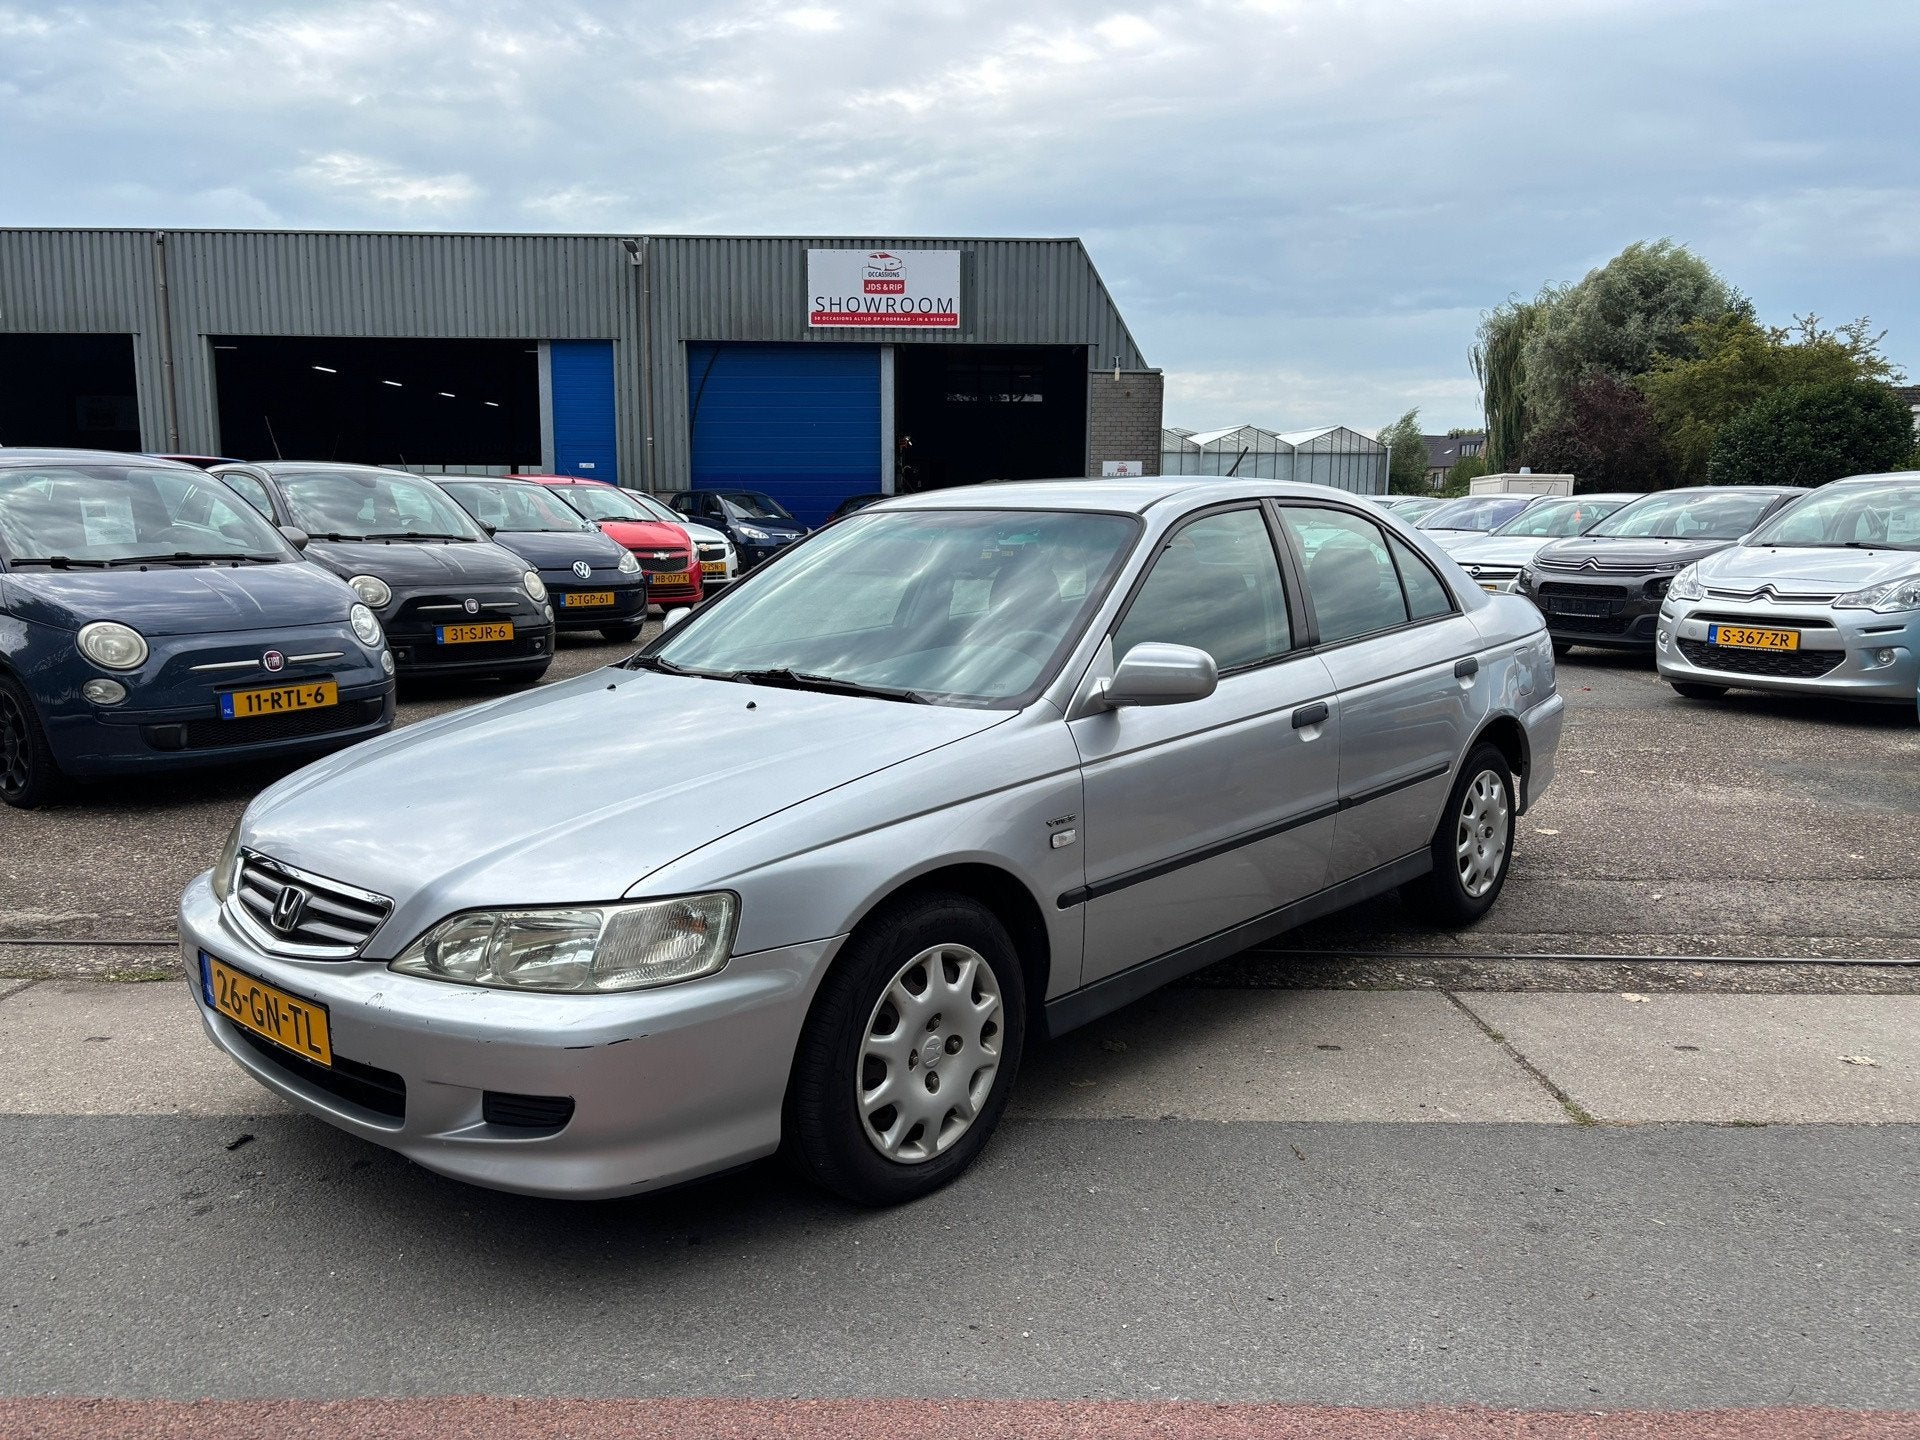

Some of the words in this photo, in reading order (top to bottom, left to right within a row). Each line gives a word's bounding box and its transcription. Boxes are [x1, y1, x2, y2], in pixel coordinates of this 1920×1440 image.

[866, 283, 882, 291] JDS
[882, 283, 889, 291] &
[815, 297, 953, 314] SHOWROOM
[655, 574, 688, 583] HB-077-K
[568, 594, 609, 605] 3-TGP-61
[450, 626, 506, 641] 31-SJR-6
[1722, 629, 1790, 647] S-367-ZR
[246, 686, 325, 712] 11-RTL-6
[216, 969, 322, 1055] 26-GN-TL
